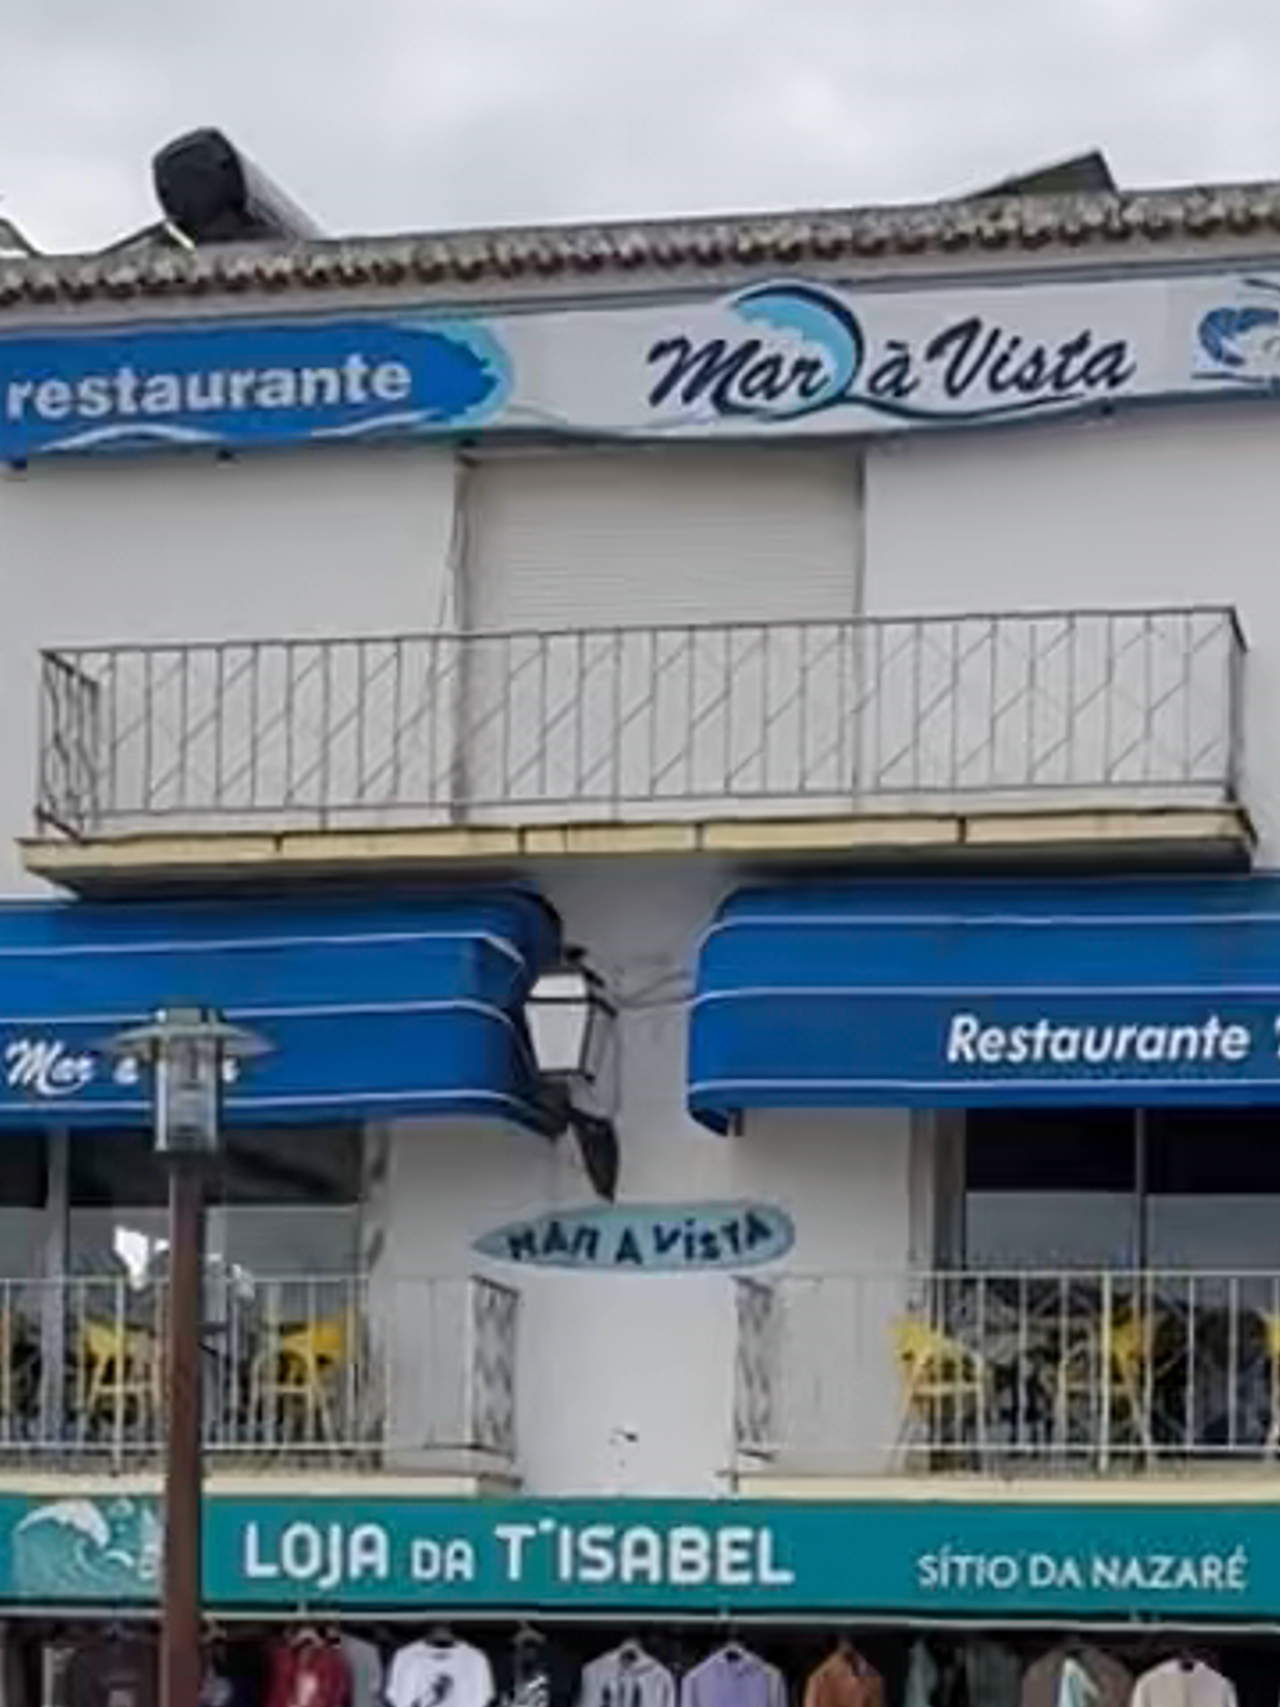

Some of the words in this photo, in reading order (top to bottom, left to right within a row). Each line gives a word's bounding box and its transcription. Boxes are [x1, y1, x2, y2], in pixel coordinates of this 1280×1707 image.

[5, 353, 412, 422] restaurante
[646, 335, 832, 409] Mar
[867, 340, 922, 398] à
[924, 316, 1137, 399] Vista
[5, 1039, 95, 1096] Mar
[946, 1013, 1252, 1064] Restaurante
[243, 1521, 390, 1589] LOJA
[411, 1538, 475, 1582] DA
[918, 1544, 1019, 1589] SÍTIO
[1029, 1553, 1082, 1589] DA
[1091, 1543, 1248, 1590] NAZARÉ
